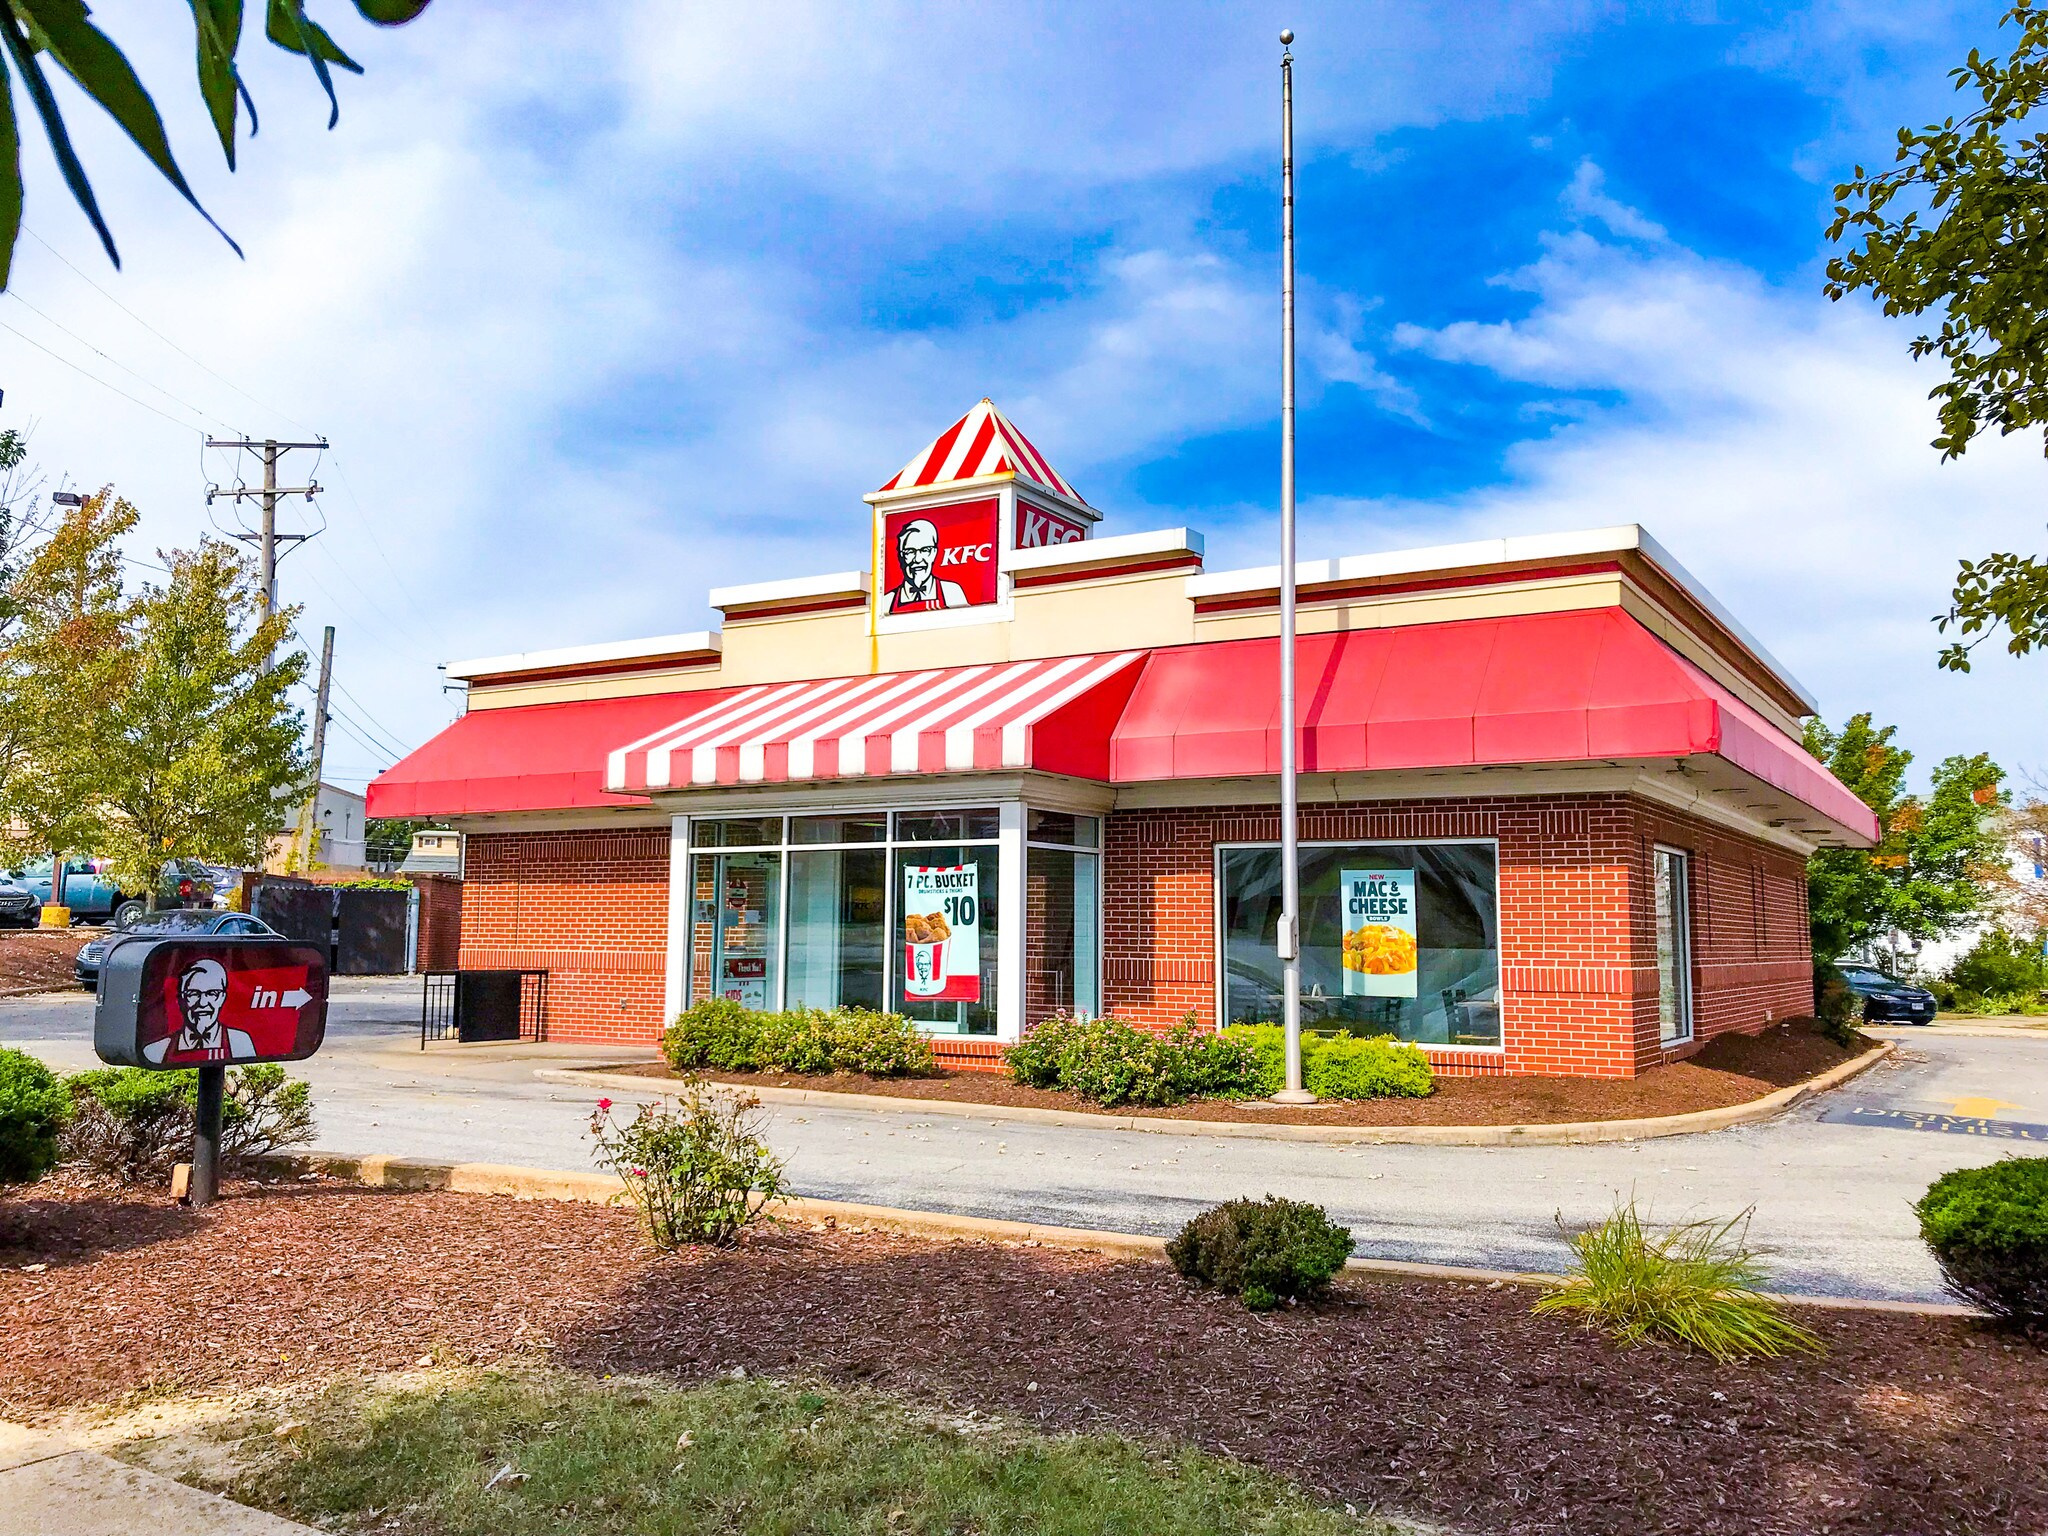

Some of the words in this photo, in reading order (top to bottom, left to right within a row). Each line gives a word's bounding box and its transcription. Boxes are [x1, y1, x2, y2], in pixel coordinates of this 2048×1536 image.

[940, 543, 993, 567] KFC
[907, 875, 913, 889] 7
[916, 875, 933, 889] PC.
[935, 873, 975, 889] BUCKET
[1353, 881, 1388, 897] MAC
[1390, 881, 1399, 893] &
[944, 895, 976, 926] $10
[1348, 898, 1408, 915] CHEESE
[250, 985, 278, 1009] in
[725, 989, 742, 1001] KIDS
[1852, 1107, 2014, 1130] DRIVE
